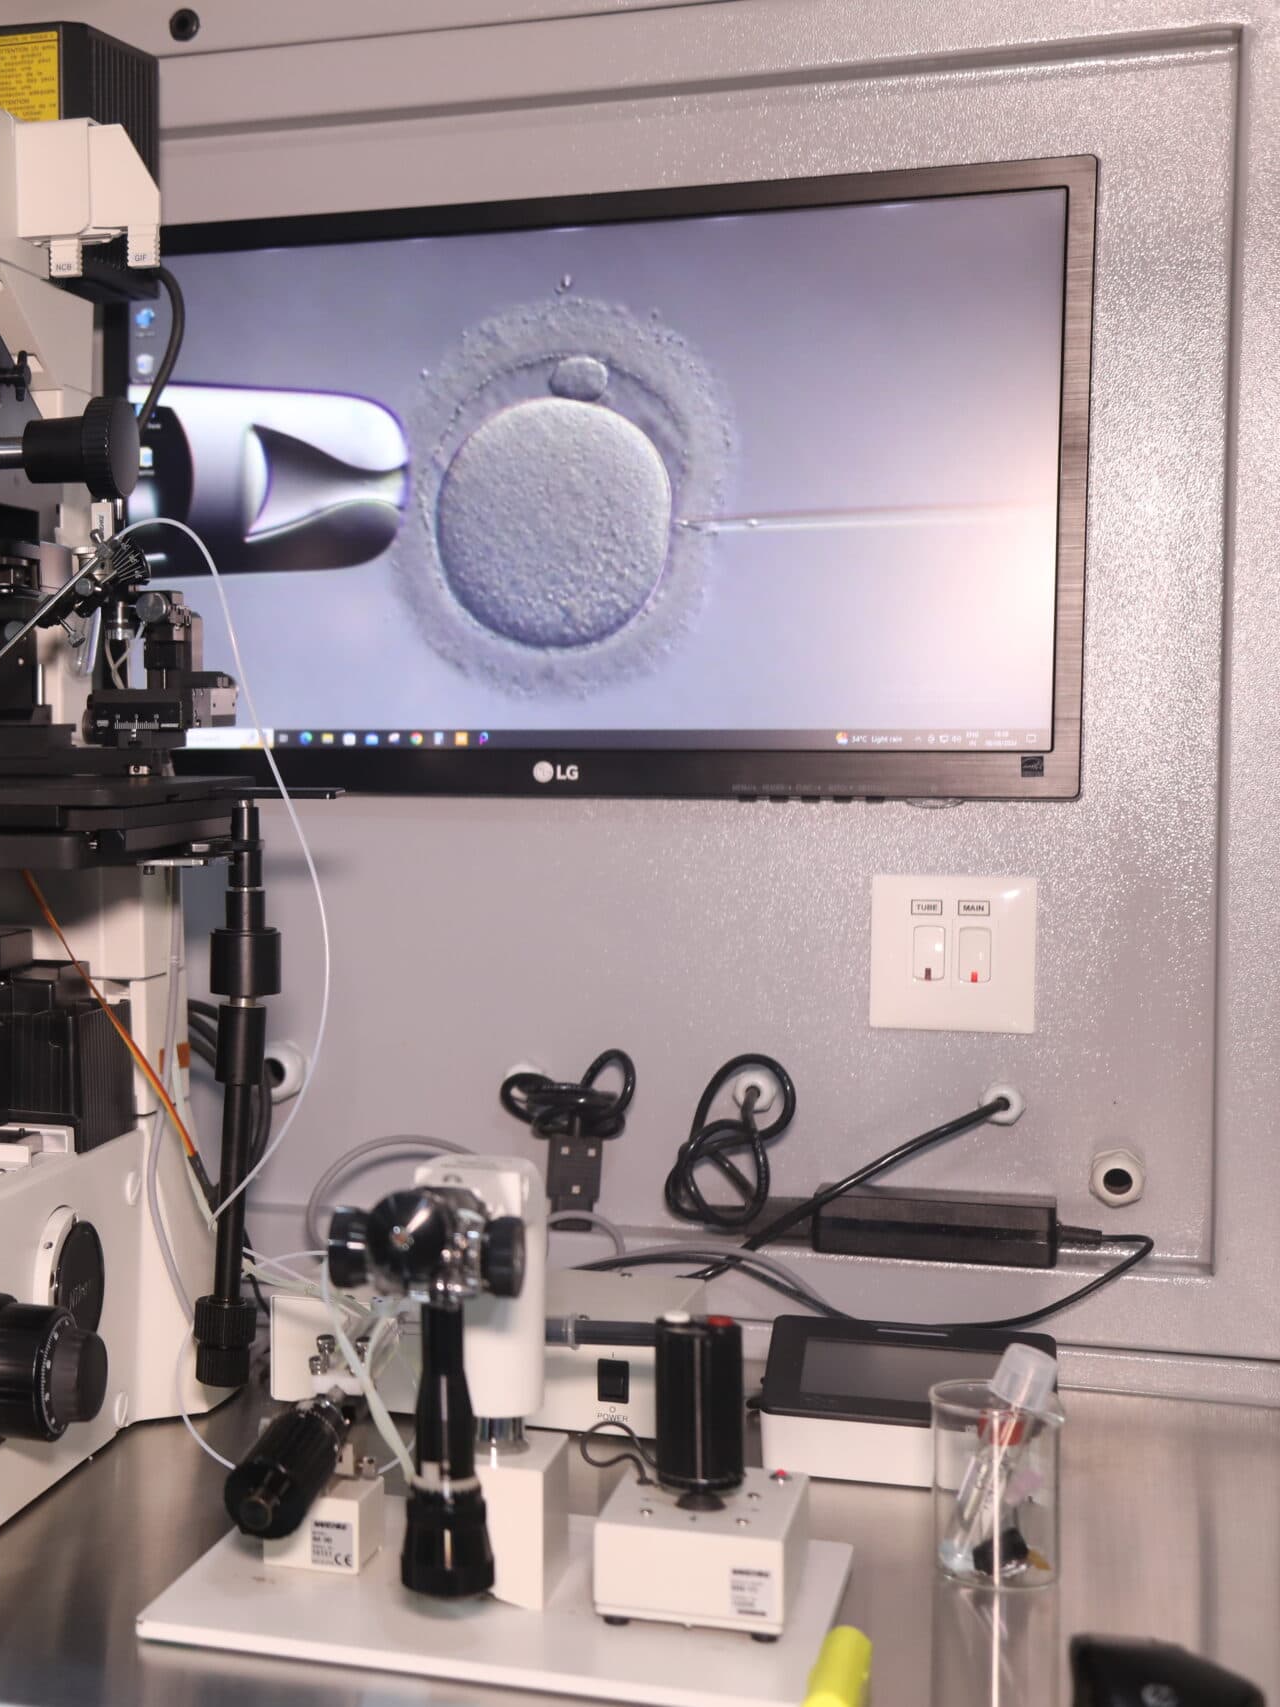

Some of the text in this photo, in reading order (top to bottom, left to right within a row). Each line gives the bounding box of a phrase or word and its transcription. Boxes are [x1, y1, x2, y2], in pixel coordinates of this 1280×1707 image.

[134, 253, 147, 262] GIF
[55, 263, 72, 272] NCB
[556, 764, 579, 781] LG
[917, 903, 937, 911] TUBE
[962, 904, 985, 912] MAIN
[597, 1412, 629, 1423] POWER
